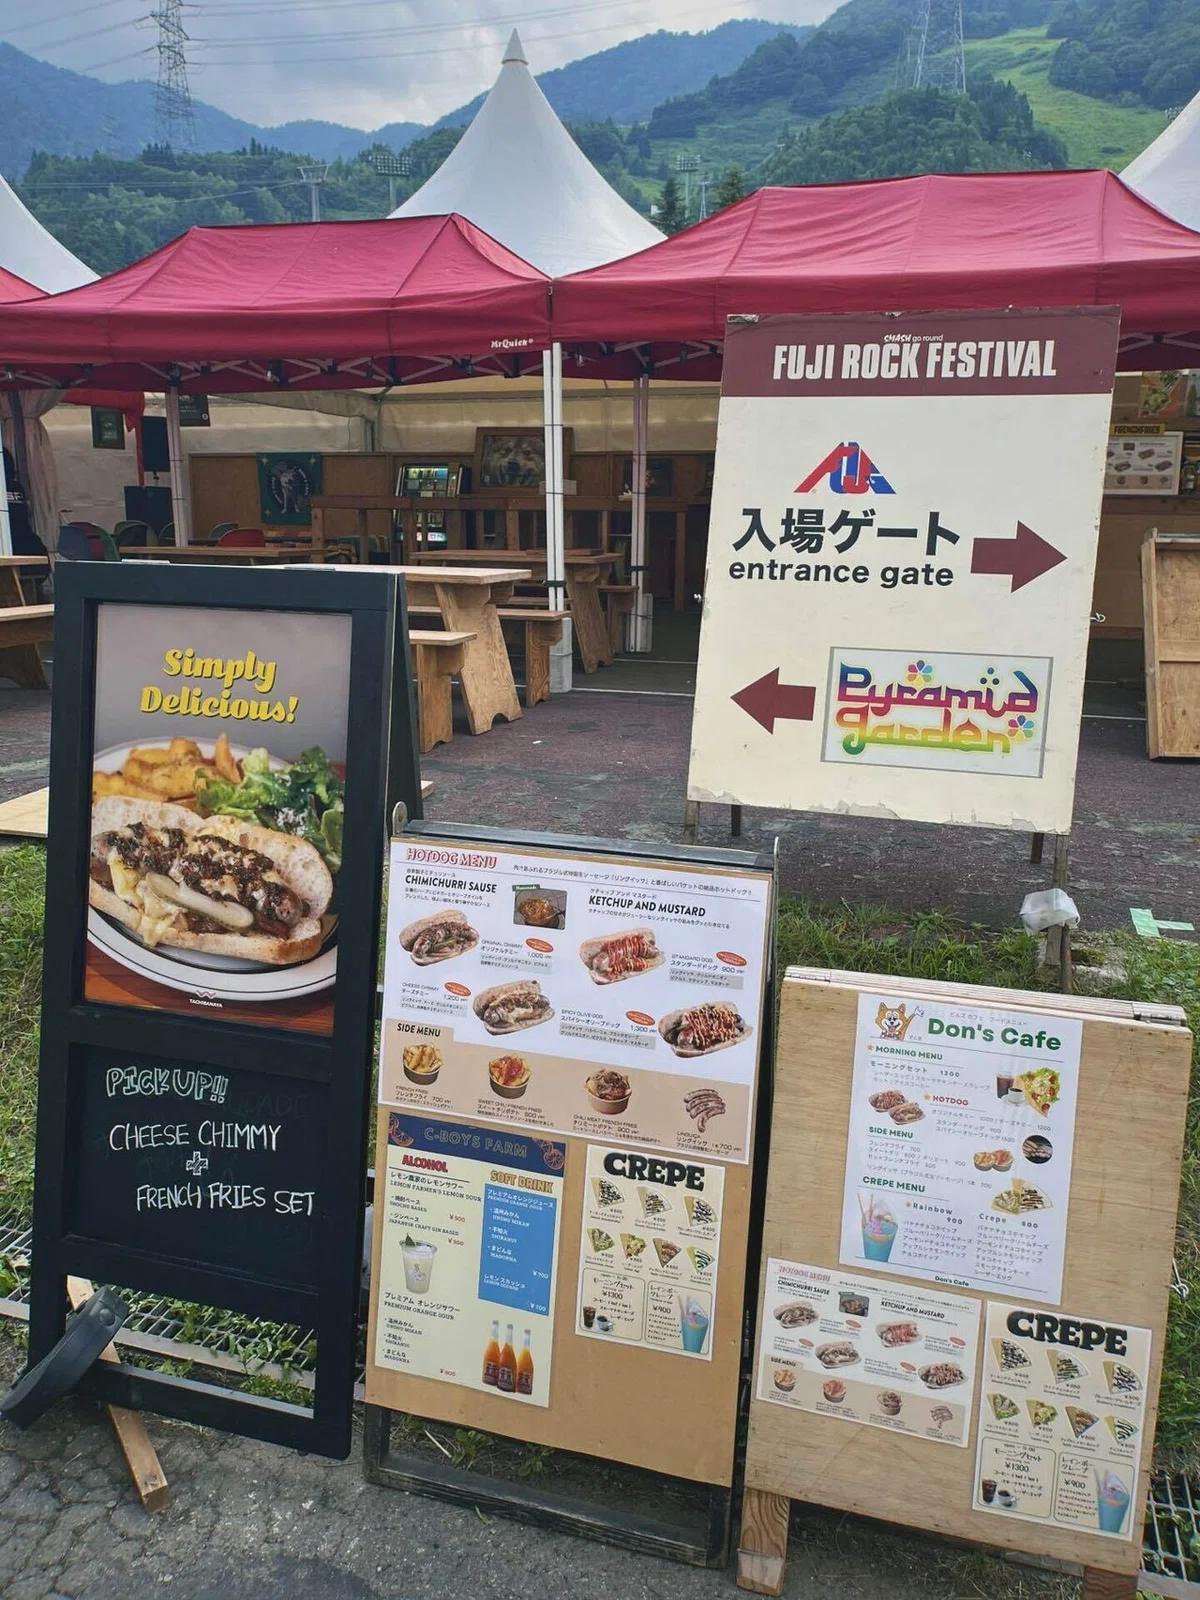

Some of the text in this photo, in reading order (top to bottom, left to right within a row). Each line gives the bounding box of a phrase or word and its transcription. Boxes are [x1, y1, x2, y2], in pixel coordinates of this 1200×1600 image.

[773, 339, 1057, 380] FUJI ROCK FESTIVAL
[732, 507, 961, 556] 入場ゲート
[728, 560, 954, 588] entrance gate
[162, 648, 277, 693] Simply
[140, 686, 299, 724] Delicious!
[836, 704, 1011, 756] garden
[406, 848, 497, 869] HOTDOG MENU
[405, 875, 498, 893] CHIMICHURRI SAUSE
[589, 895, 706, 917] KETCHUP AND MUSTARD
[397, 1023, 441, 1038] SIDE MENU
[928, 1017, 1061, 1050] Don's Cafe
[876, 1045, 943, 1060] MORNING MENU
[870, 1060, 927, 1073] モーニングセット
[106, 1066, 230, 1104] PICK UP!!
[933, 1095, 969, 1106] HOTDOG
[109, 1120, 281, 1151] CHEESE CHIMMY
[869, 1126, 913, 1138] SIDE MENU
[424, 1127, 527, 1158] C-BOYS FARM
[402, 1154, 448, 1173] ALCOHOL
[603, 1152, 705, 1192] CREPE
[391, 1172, 464, 1189] レモン農家のレモンサワー
[490, 1170, 554, 1193] SOFT DRINK
[862, 1176, 926, 1193] CREPE MENU
[137, 1182, 315, 1216] FRENCH FRIES SET
[390, 1180, 411, 1189] LEMON
[443, 1190, 464, 1198] LEMON
[466, 1194, 481, 1202] SOUR
[913, 1203, 952, 1215] Rainbow
[979, 1213, 1006, 1223] Crepe
[947, 1217, 962, 1225] 900
[934, 1276, 952, 1284] Don's
[602, 1290, 623, 1299] ¥1300
[813, 1287, 830, 1295] SAUSE
[384, 1301, 411, 1311] PREMIUM
[413, 1307, 437, 1316] ORANGE
[385, 1292, 460, 1312] プレミアム オレンジサワー
[653, 1305, 671, 1314] ¥900
[881, 1301, 906, 1310] KETCHUP
[919, 1309, 945, 1319] MUSTARD
[1006, 1310, 1127, 1357] CREPE
[1005, 1462, 1029, 1472] ¥1300
[1064, 1479, 1086, 1489] ¥900
